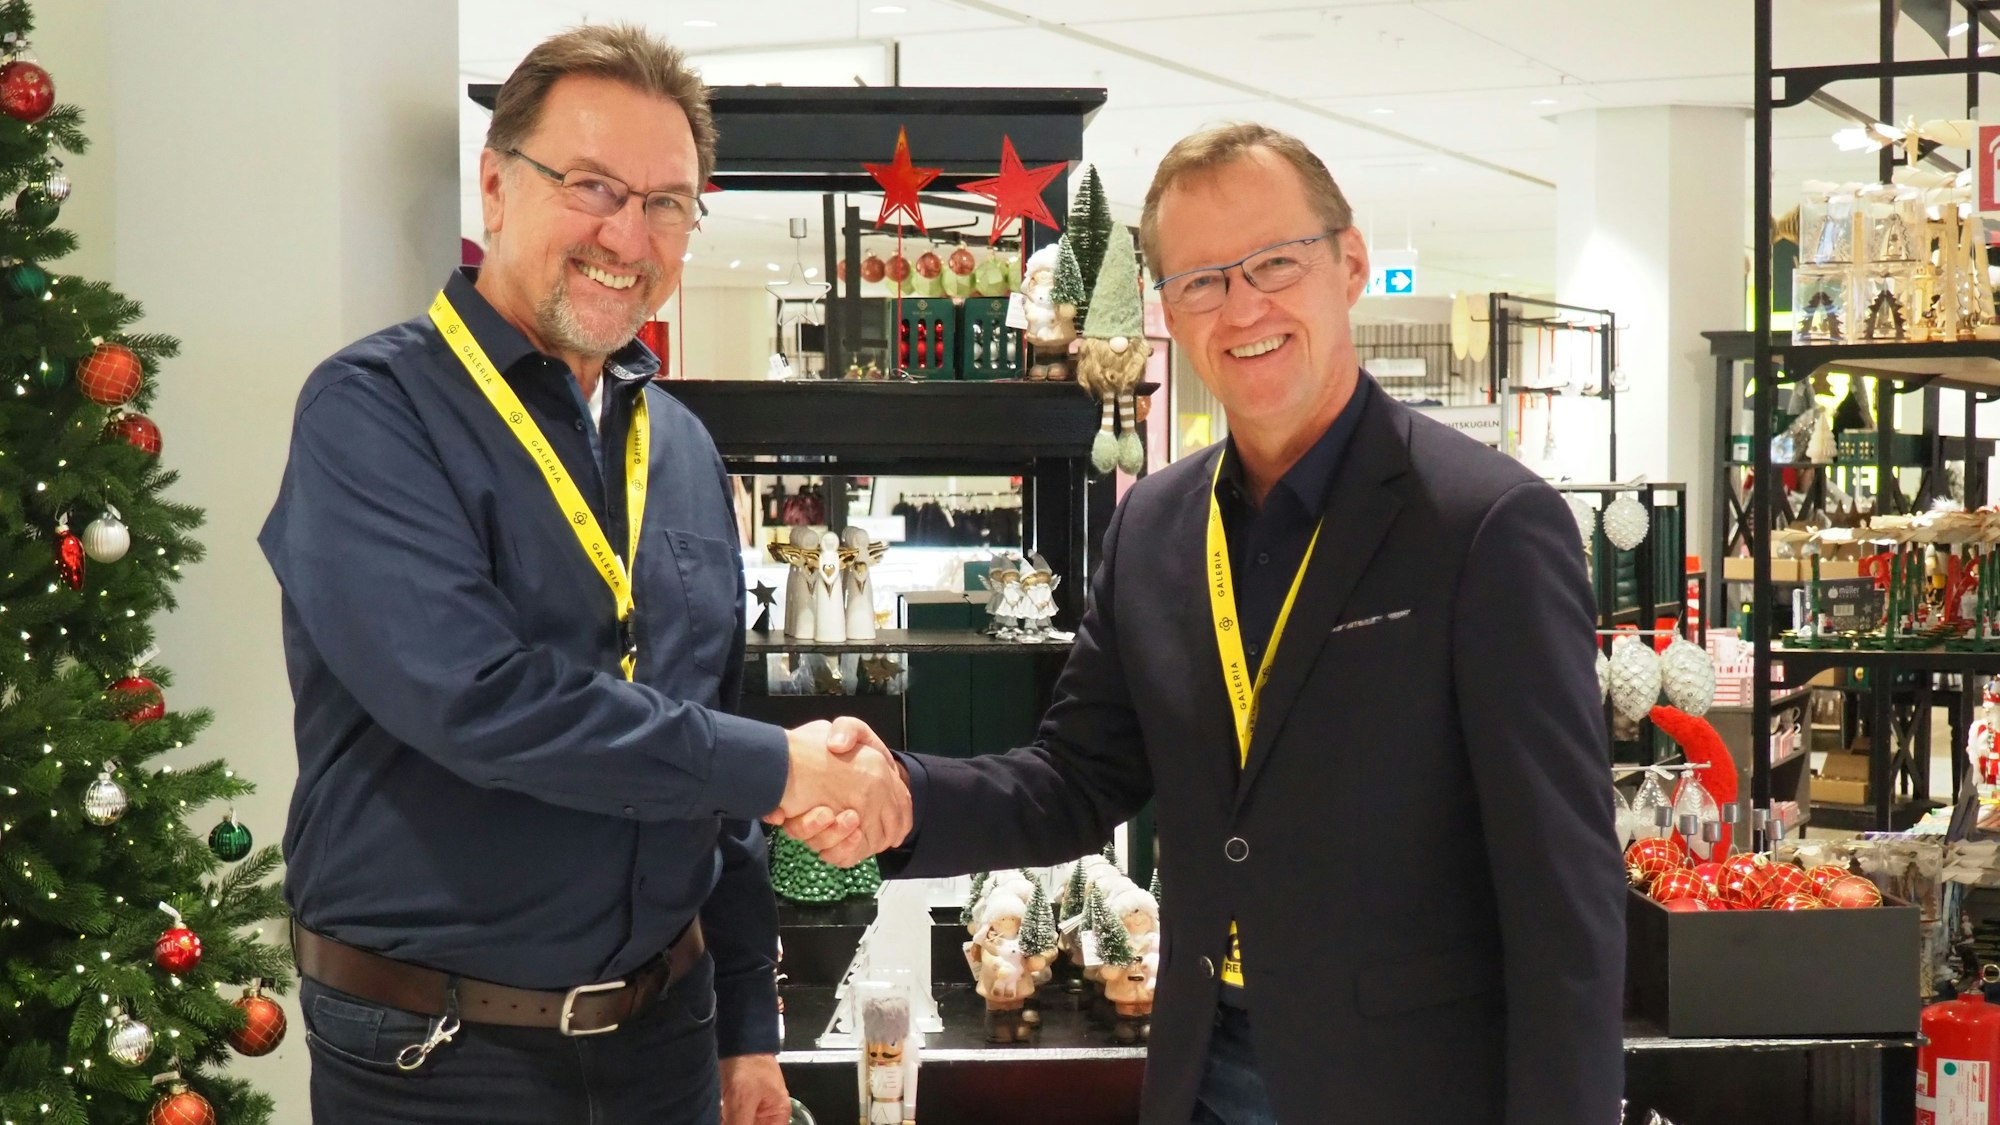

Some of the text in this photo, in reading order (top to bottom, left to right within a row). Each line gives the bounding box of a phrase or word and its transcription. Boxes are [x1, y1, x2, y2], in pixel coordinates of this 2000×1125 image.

[463, 345, 492, 385] GALERIA
[531, 440, 562, 484] GALERIA
[634, 428, 642, 465] GALERIA
[592, 542, 620, 589] GALERIA
[1214, 550, 1226, 598] GALERIA
[1231, 661, 1247, 710] GALERIA
